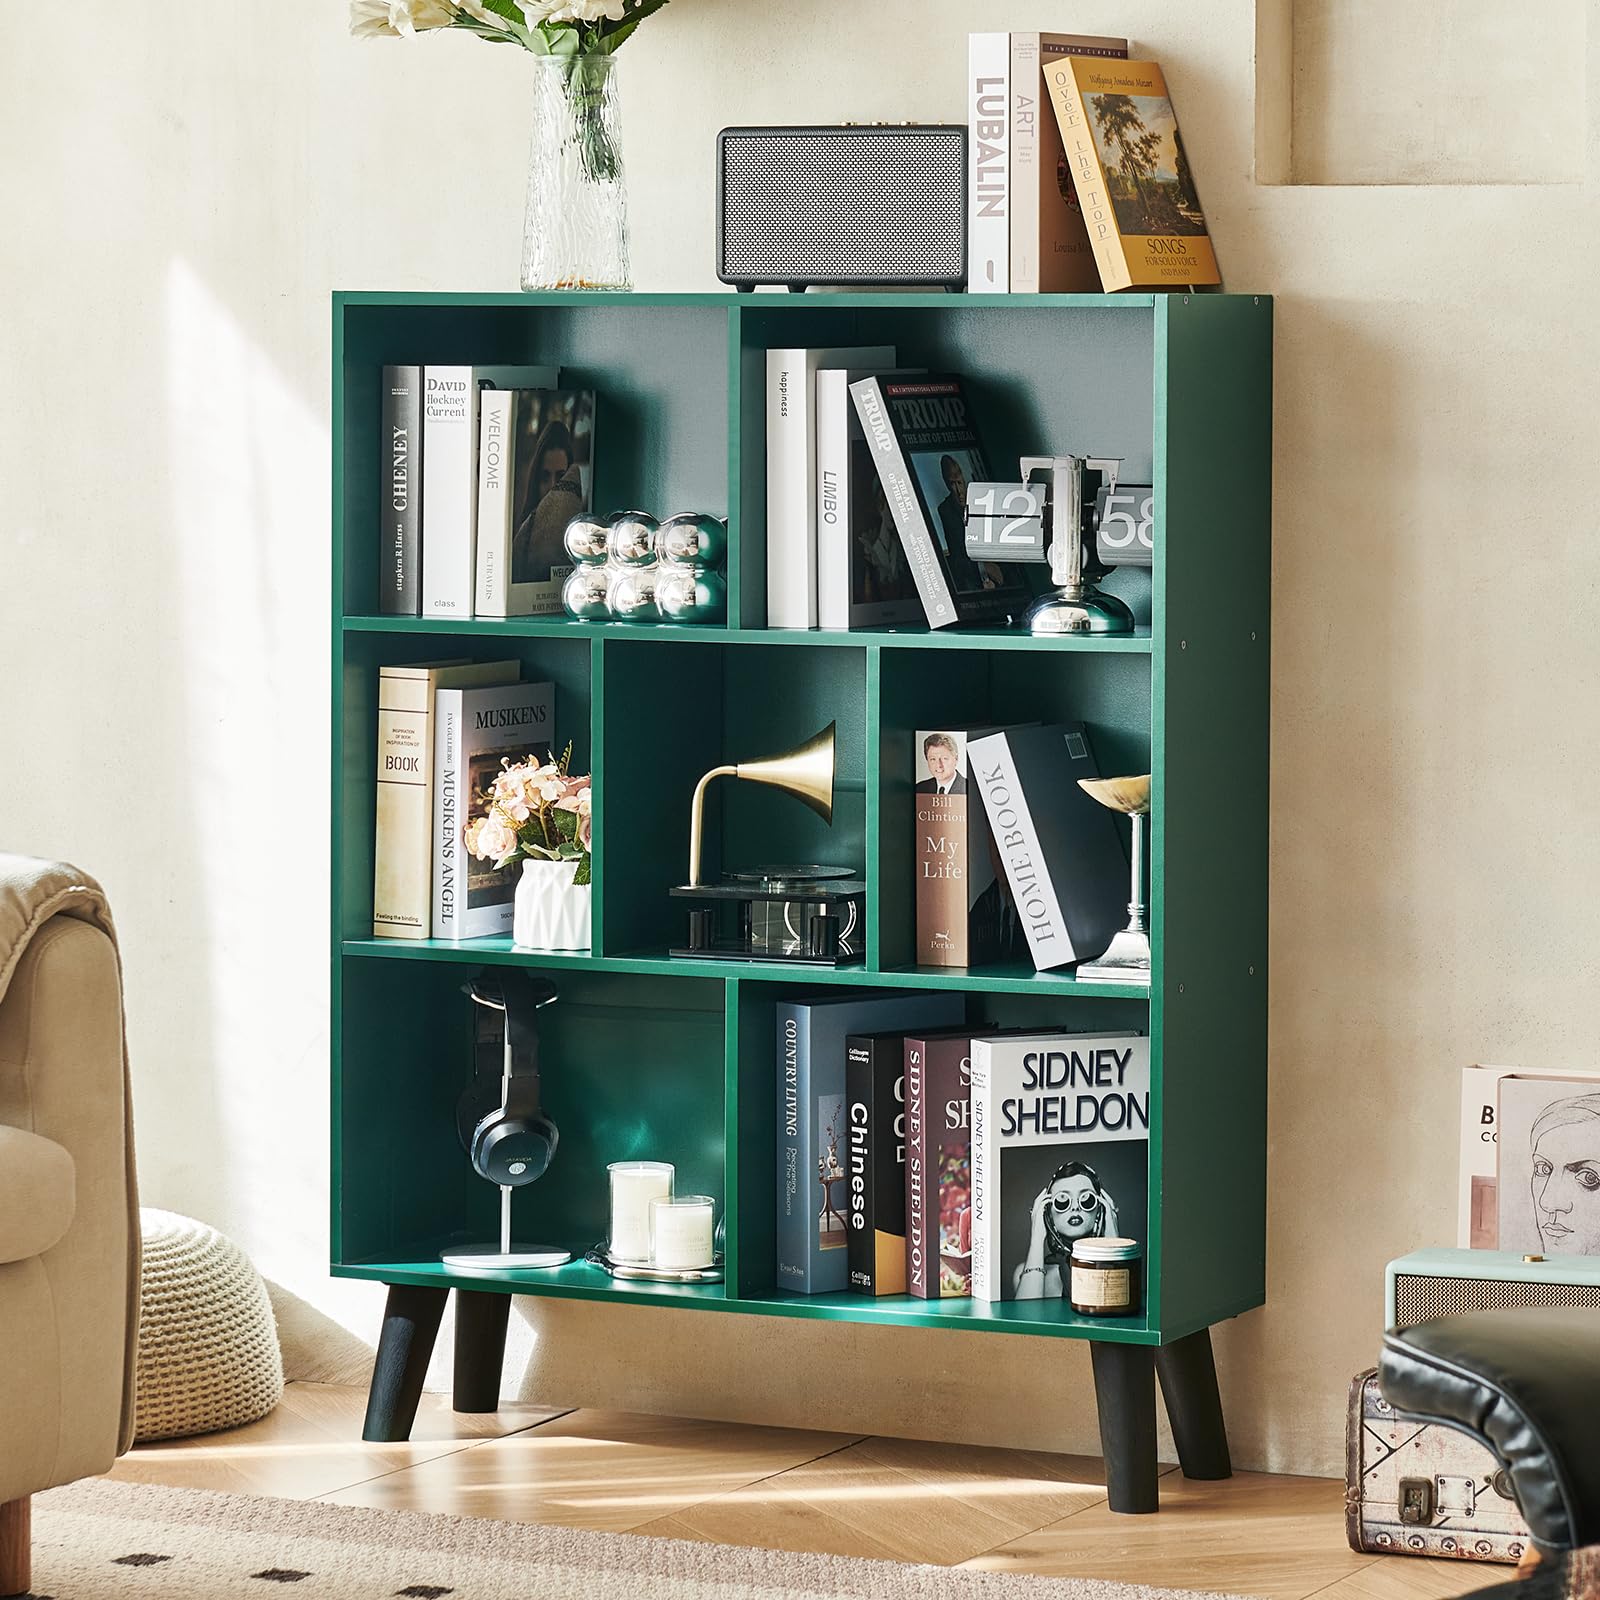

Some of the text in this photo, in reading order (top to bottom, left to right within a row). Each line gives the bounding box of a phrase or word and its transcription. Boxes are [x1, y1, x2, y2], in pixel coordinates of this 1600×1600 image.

[1016, 94, 1035, 137] ART
[976, 77, 1005, 217] LUBALIN
[1055, 71, 1108, 239] Over the Top
[1146, 238, 1187, 255] SONGS
[427, 378, 467, 391] DAVID
[427, 394, 467, 406] Hockney
[780, 371, 789, 417] happiness
[426, 406, 465, 417] Current
[860, 388, 893, 453] TRUMP
[892, 398, 967, 430] TRUMP
[486, 409, 502, 489] WELCOME
[902, 433, 919, 445] THE
[919, 432, 932, 444] ART
[931, 432, 941, 443] OF
[941, 431, 957, 442] THE
[393, 426, 408, 511] CHENEY
[823, 470, 838, 525] LIMBO
[888, 473, 910, 523] OF THE DEAL
[898, 478, 914, 512] THE ART
[974, 489, 1037, 544] 12
[1100, 495, 1154, 548] 58
[552, 567, 573, 577] WELC
[434, 600, 456, 608] class
[475, 704, 546, 729] MUSIKENS
[385, 755, 419, 772] BOOK
[931, 797, 953, 808] Bill
[441, 769, 455, 924] MUSIKENS ANGEL
[926, 836, 959, 859] My
[982, 763, 1056, 943] HOME BOOK
[923, 861, 962, 879] Life
[785, 1019, 798, 1137] COUNTRY LIVING
[1021, 1048, 1133, 1090] SIDNEY
[1000, 1091, 1149, 1136] SHELDON
[850, 1102, 869, 1230] Chinese
[909, 1050, 923, 1288] SIDNEY SHELDON
[975, 1099, 983, 1221] SIDNEY SHELDON
